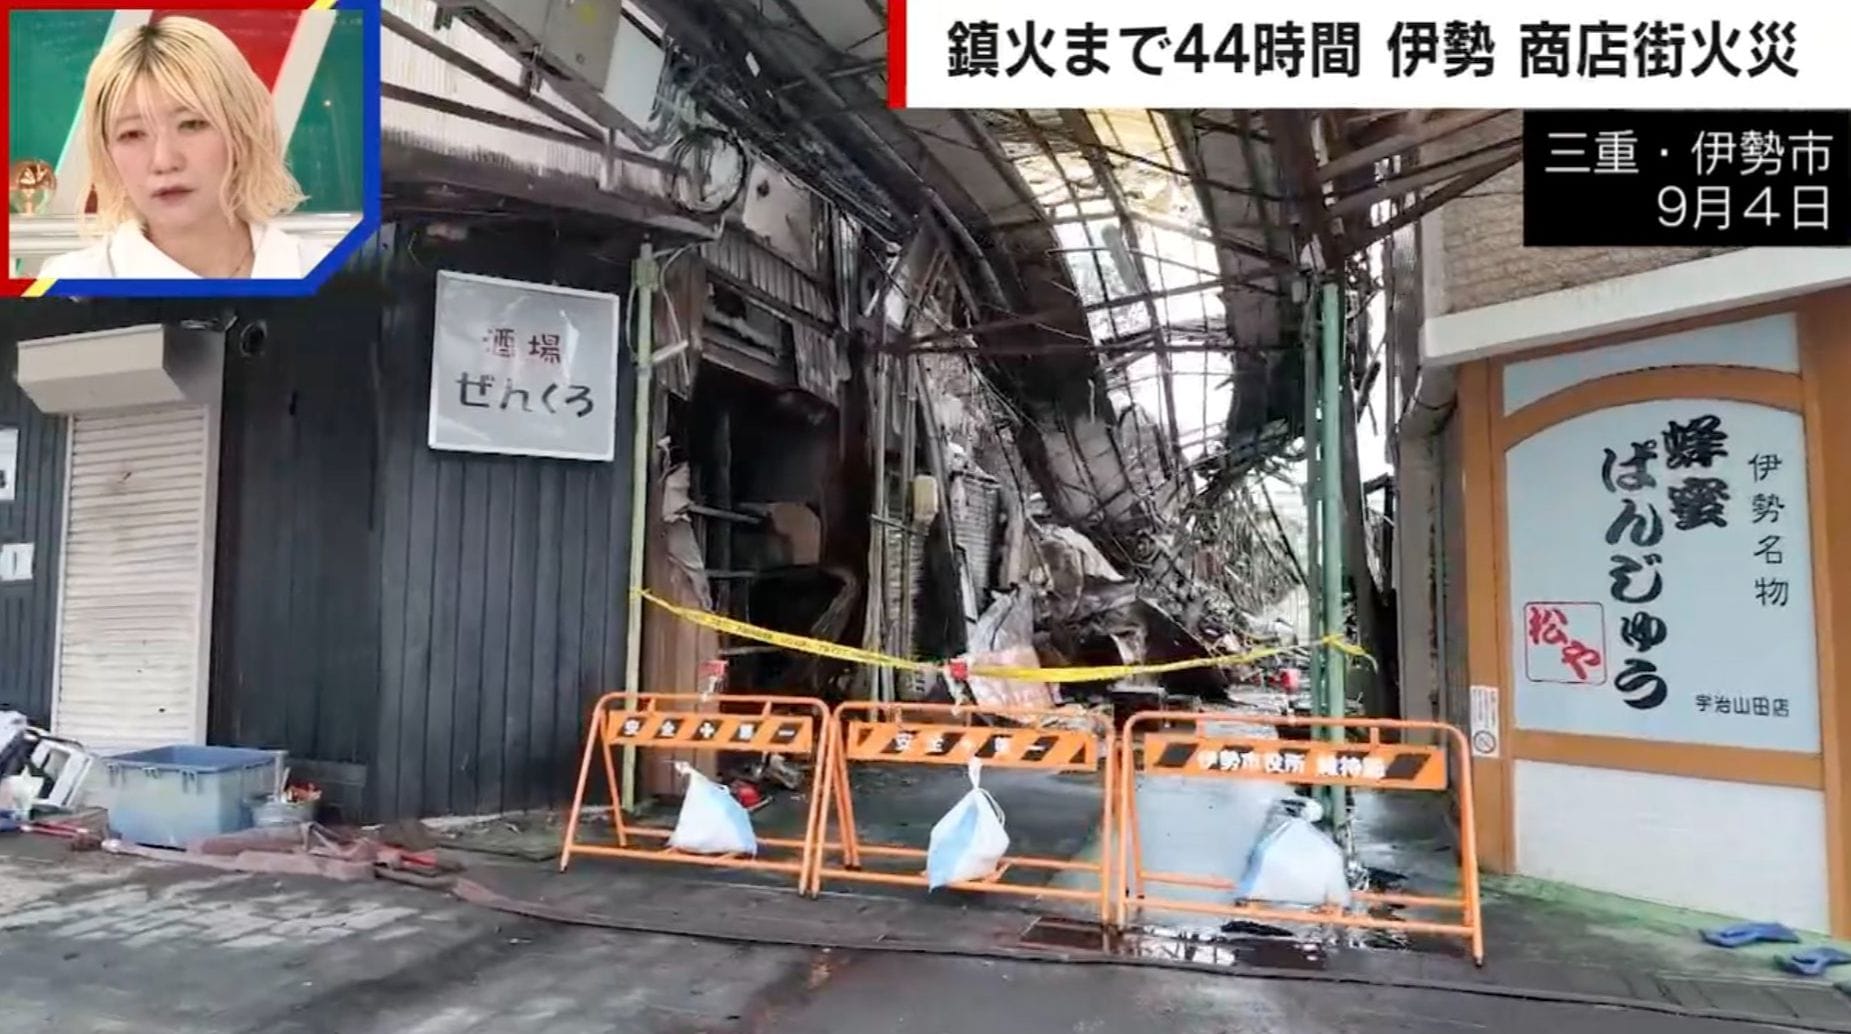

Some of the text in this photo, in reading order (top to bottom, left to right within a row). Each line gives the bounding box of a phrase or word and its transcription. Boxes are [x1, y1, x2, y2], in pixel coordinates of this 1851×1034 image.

[483, 327, 561, 364] 酒場
[456, 371, 594, 418] ぜんくろ
[1661, 414, 1730, 531] 蜂蜜
[1747, 453, 1789, 607] 伊勢名物
[1529, 606, 1601, 680] 松や
[1694, 693, 1790, 718] 宇治山田店
